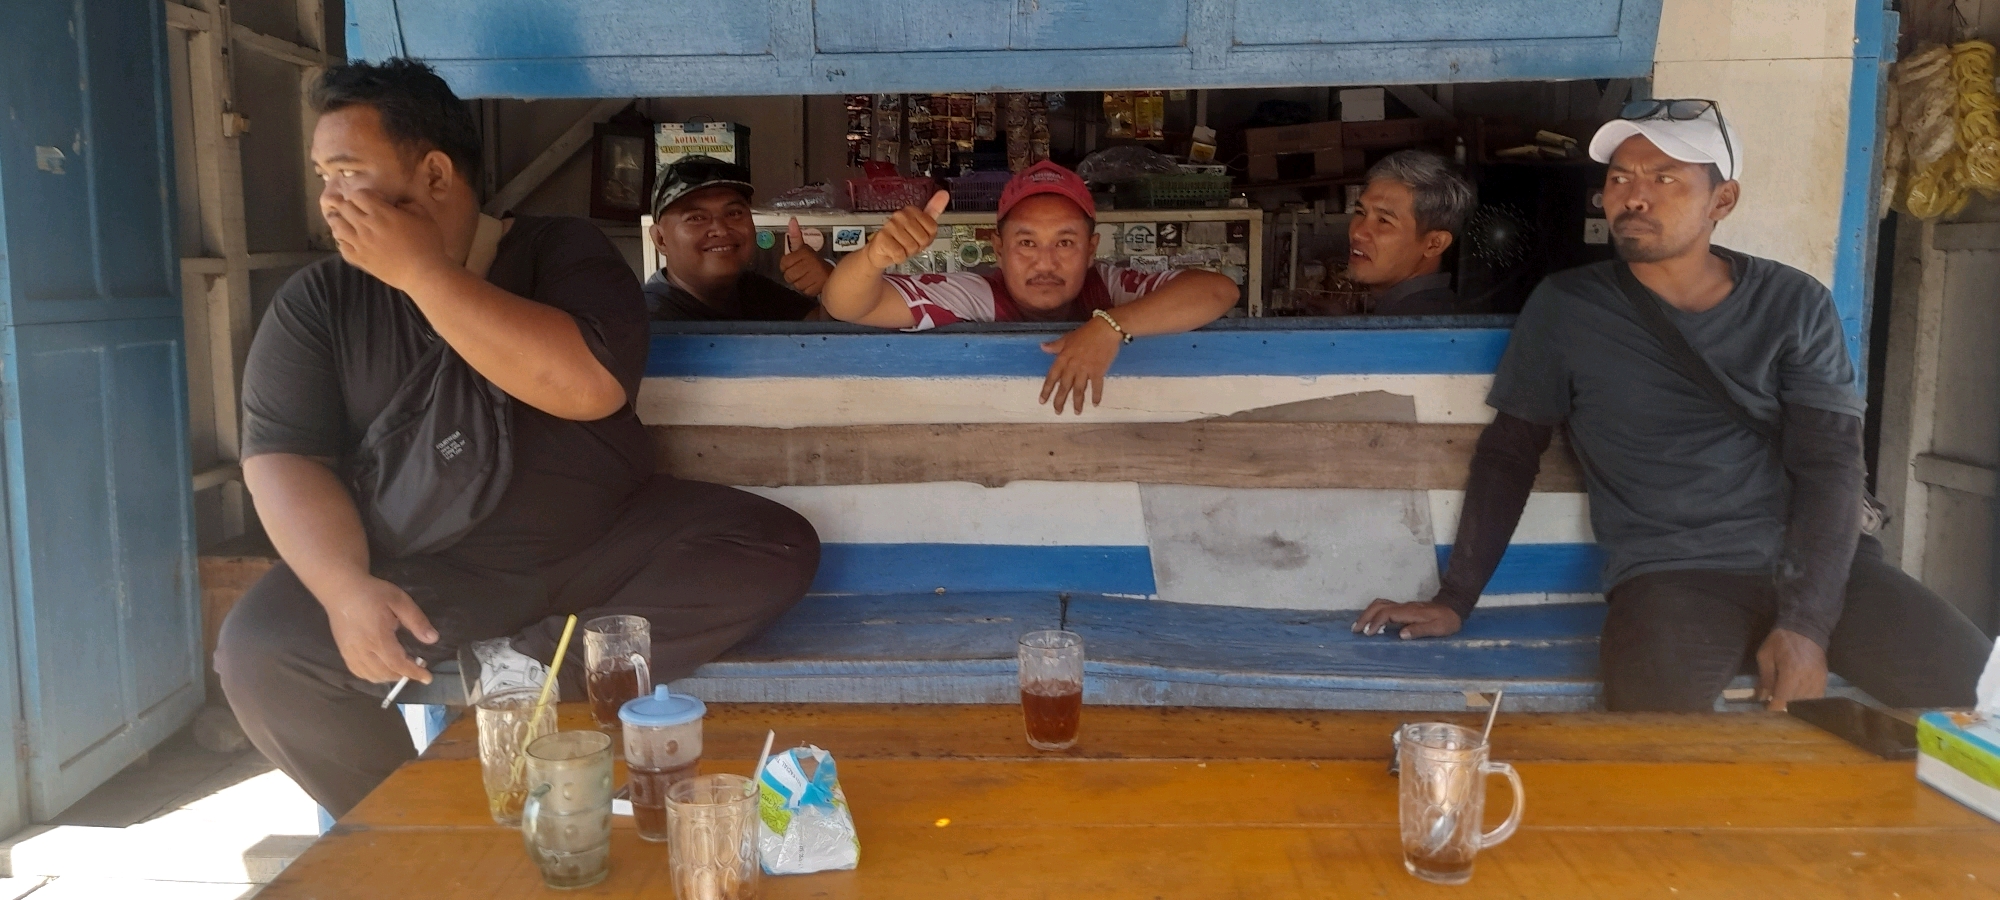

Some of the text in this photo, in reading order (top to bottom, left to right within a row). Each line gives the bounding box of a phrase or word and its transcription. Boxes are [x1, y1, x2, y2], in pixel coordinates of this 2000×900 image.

[674, 135, 717, 144] KOTAK AMAL
[1125, 234, 1155, 244] GSC
